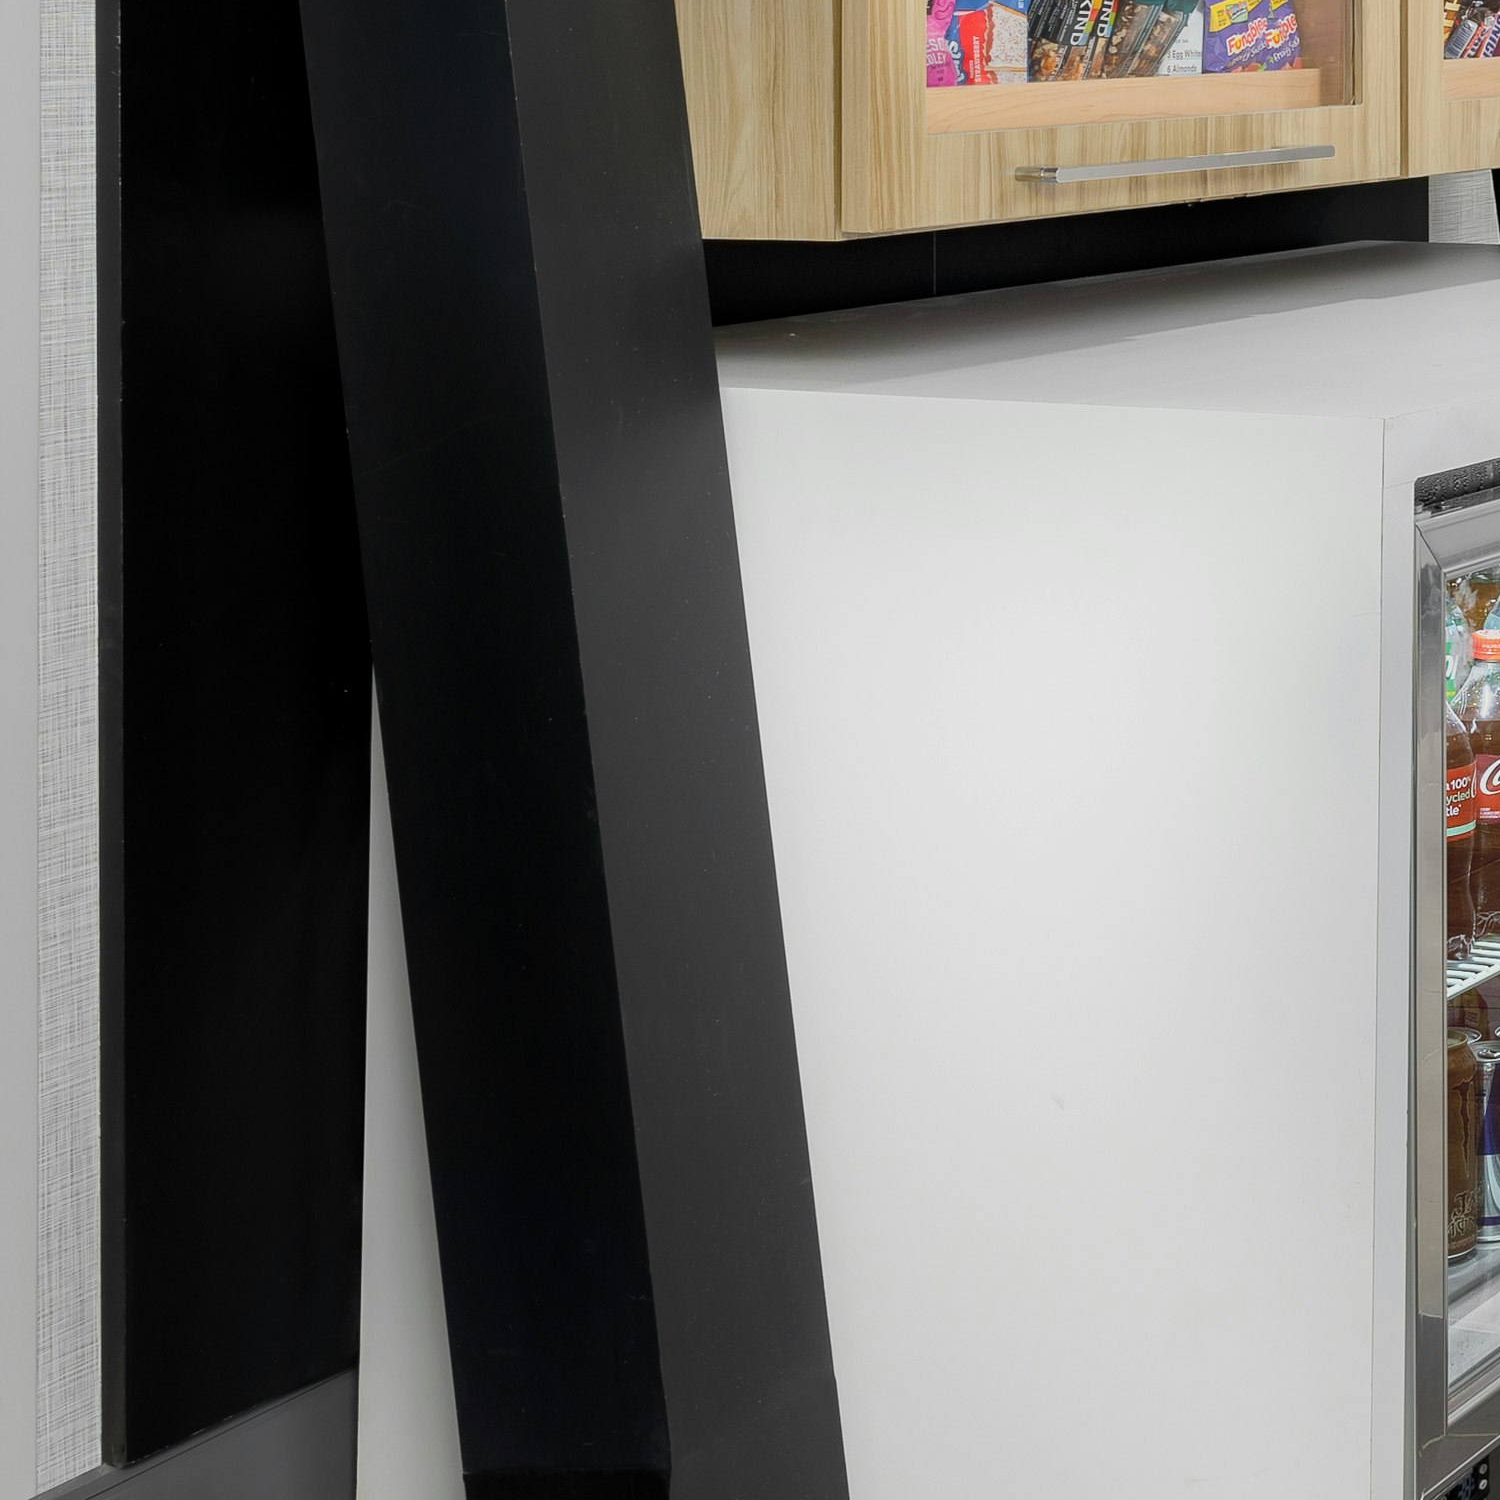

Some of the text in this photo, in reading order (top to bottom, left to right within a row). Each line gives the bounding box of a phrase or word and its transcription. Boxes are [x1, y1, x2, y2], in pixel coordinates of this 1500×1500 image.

[972, 35, 982, 83] STRAWBERRY
[1172, 50, 1184, 62] Egg
[1172, 65, 1197, 74] Almonds
